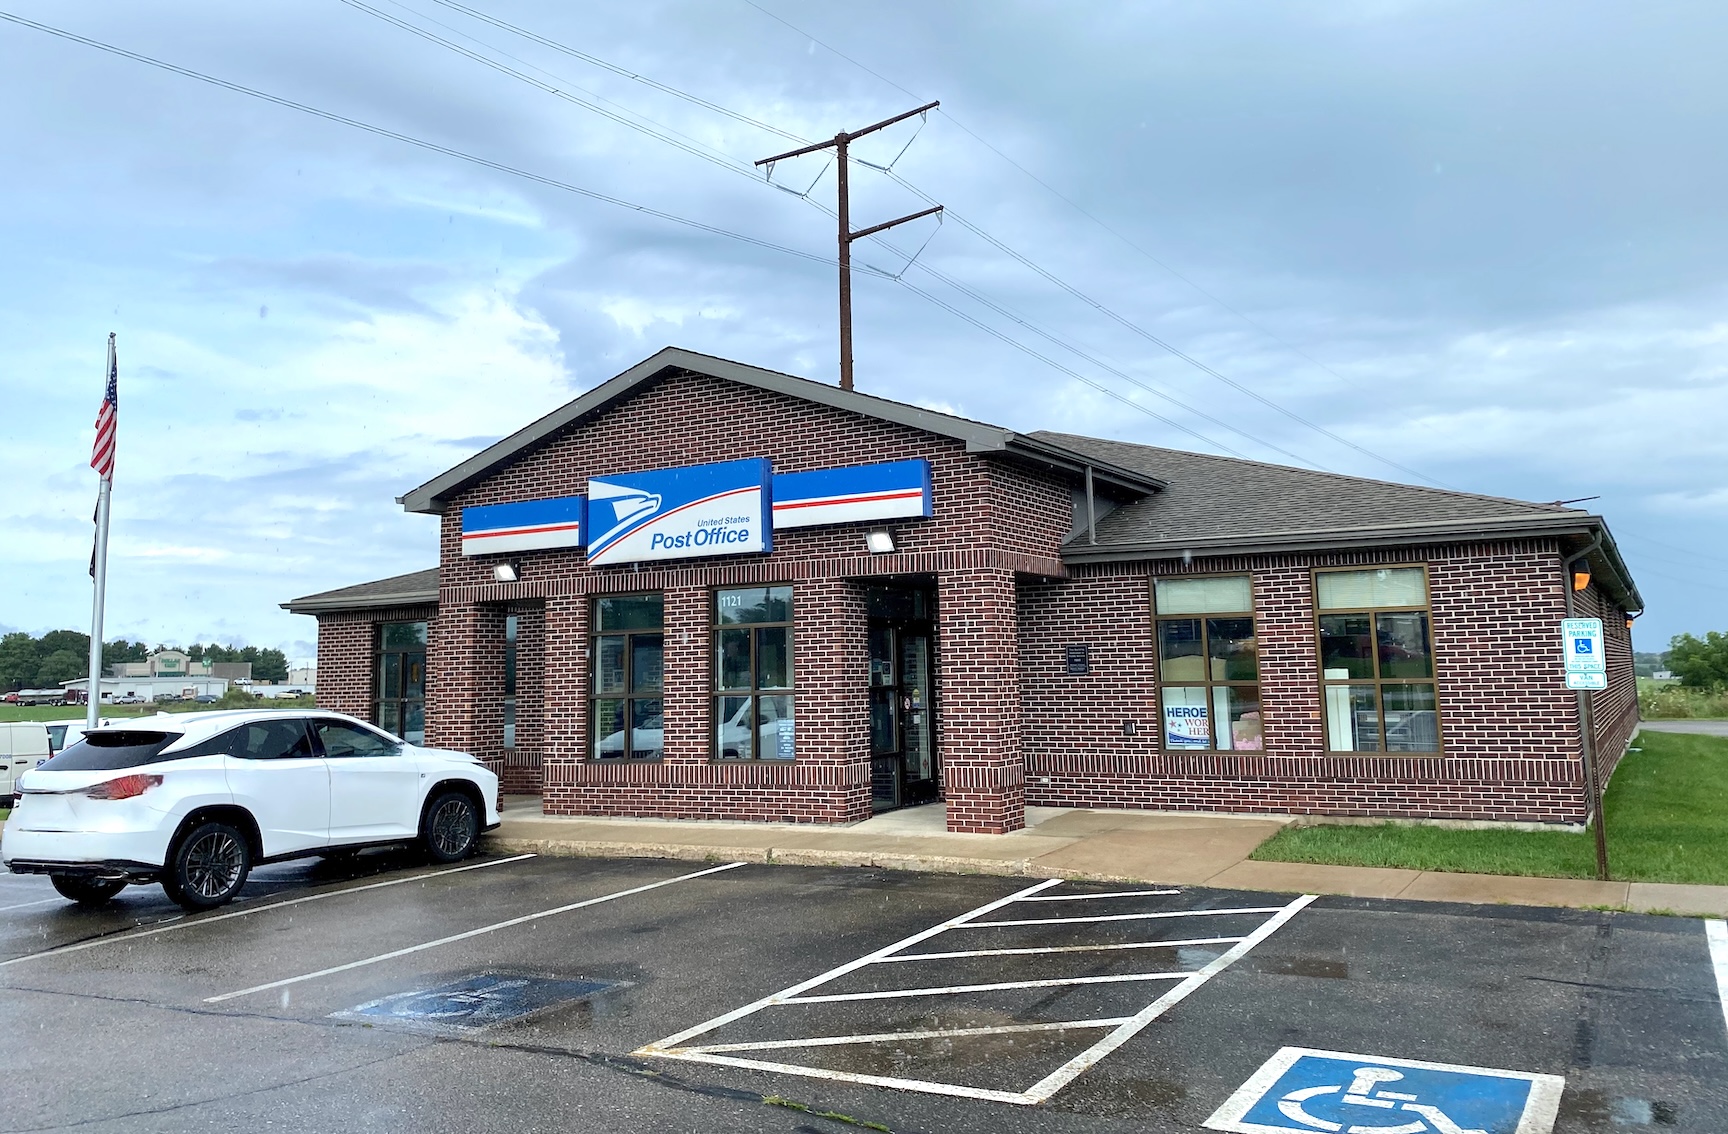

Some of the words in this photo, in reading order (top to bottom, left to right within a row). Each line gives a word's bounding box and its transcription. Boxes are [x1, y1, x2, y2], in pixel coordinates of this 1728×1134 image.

[697, 518, 723, 527] United
[724, 516, 750, 525] States
[651, 531, 692, 550] Post
[694, 526, 749, 546] Office
[721, 595, 741, 607] 1121
[1166, 707, 1207, 717] HEROE
[1184, 718, 1208, 727] WOR
[1188, 727, 1210, 736] HER
